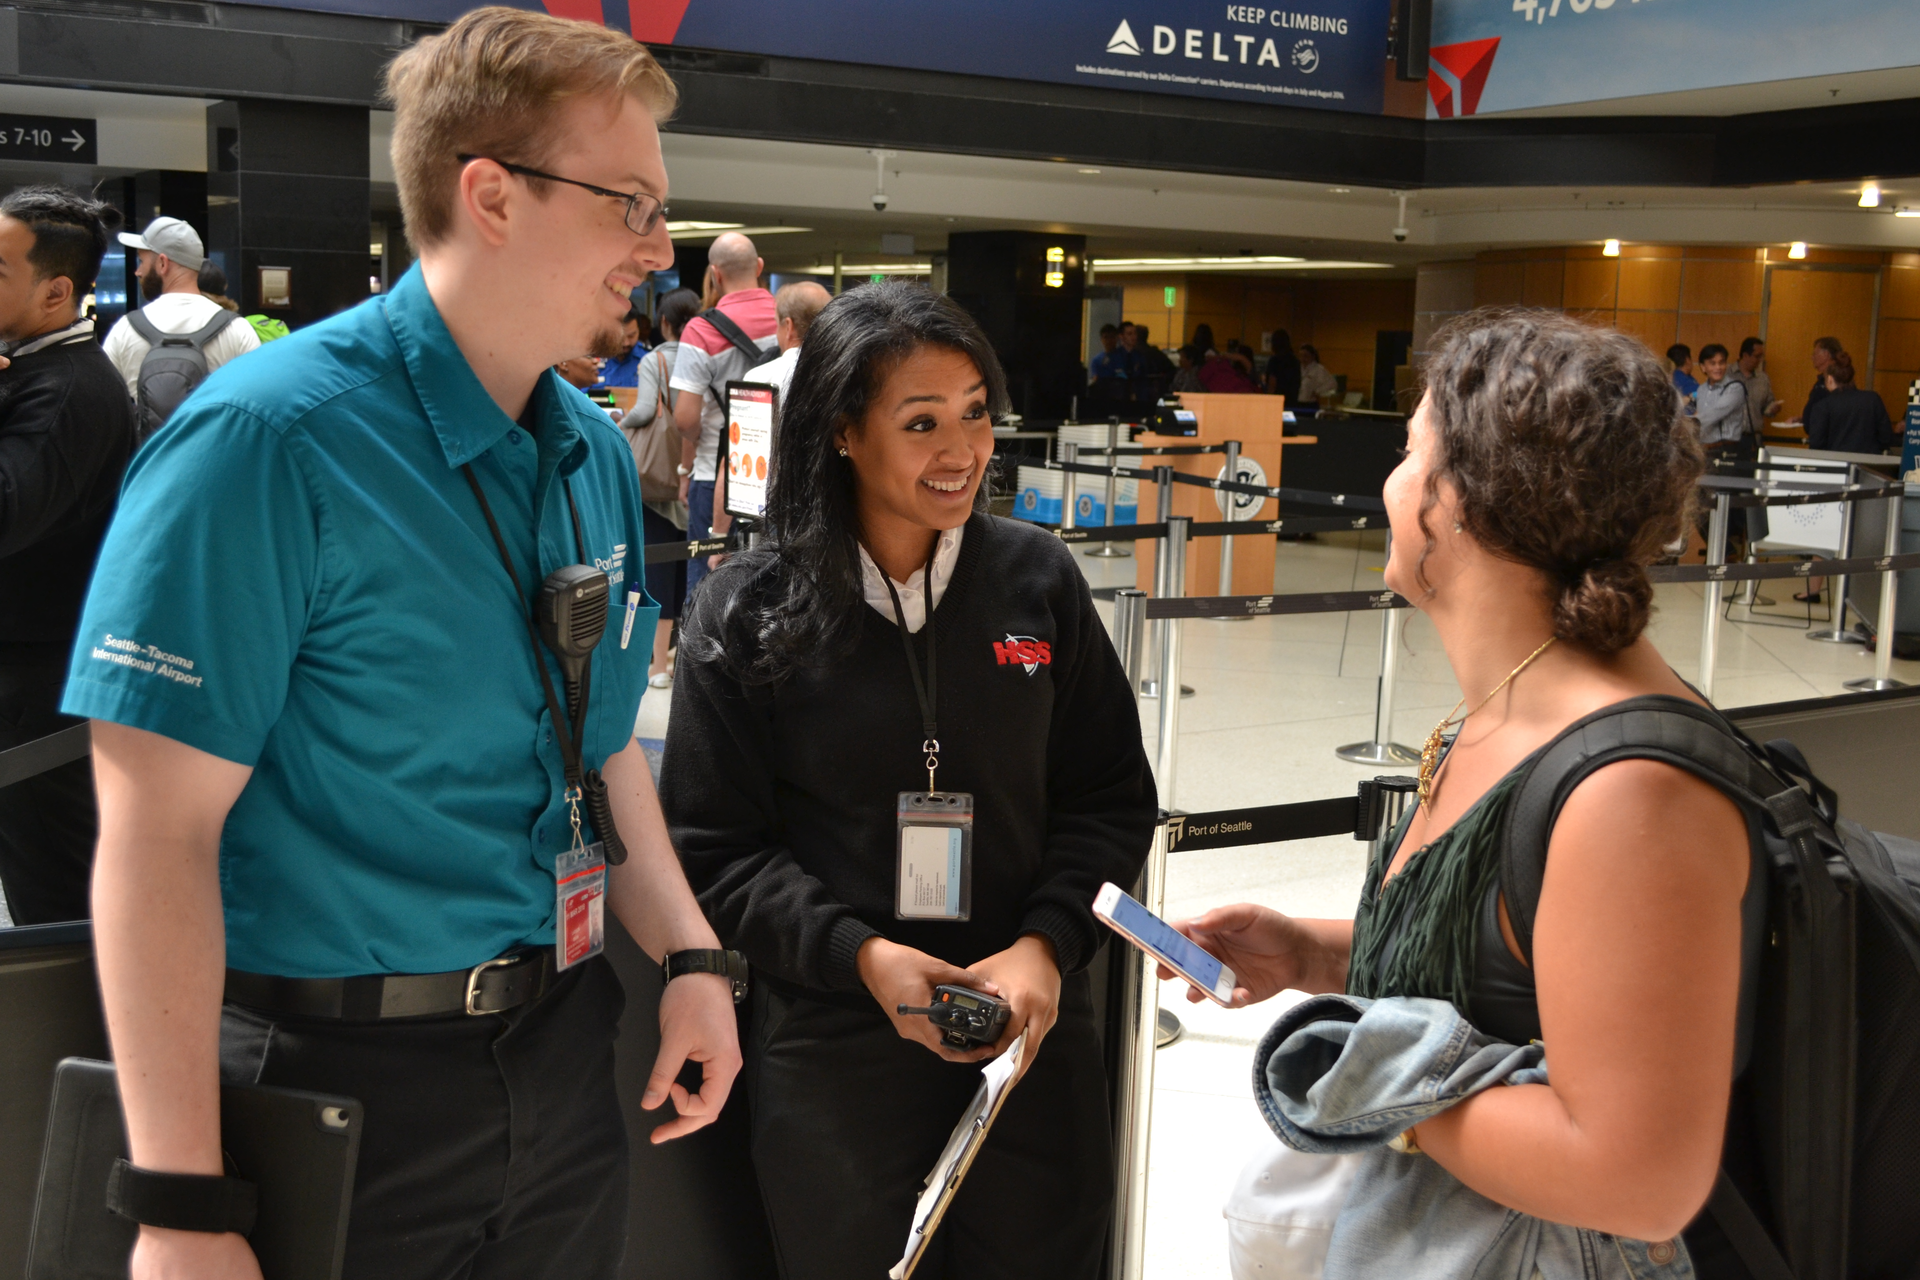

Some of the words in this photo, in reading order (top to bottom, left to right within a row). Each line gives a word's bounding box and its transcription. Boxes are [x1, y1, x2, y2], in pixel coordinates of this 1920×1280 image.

[1227, 4, 1266, 24] KEEP
[1270, 10, 1349, 35] CLIMBING
[1153, 25, 1281, 68] DELTA
[14, 128, 52, 147] 7-10
[712, 542, 725, 550] Seattle
[594, 558, 613, 571] Port
[1254, 606, 1271, 614] Seattle
[992, 640, 1052, 666] HSS
[93, 647, 156, 672] International
[157, 664, 203, 687] Airport
[1188, 825, 1207, 837] Port
[1209, 824, 1218, 834] of
[1220, 820, 1253, 834] Seattle
